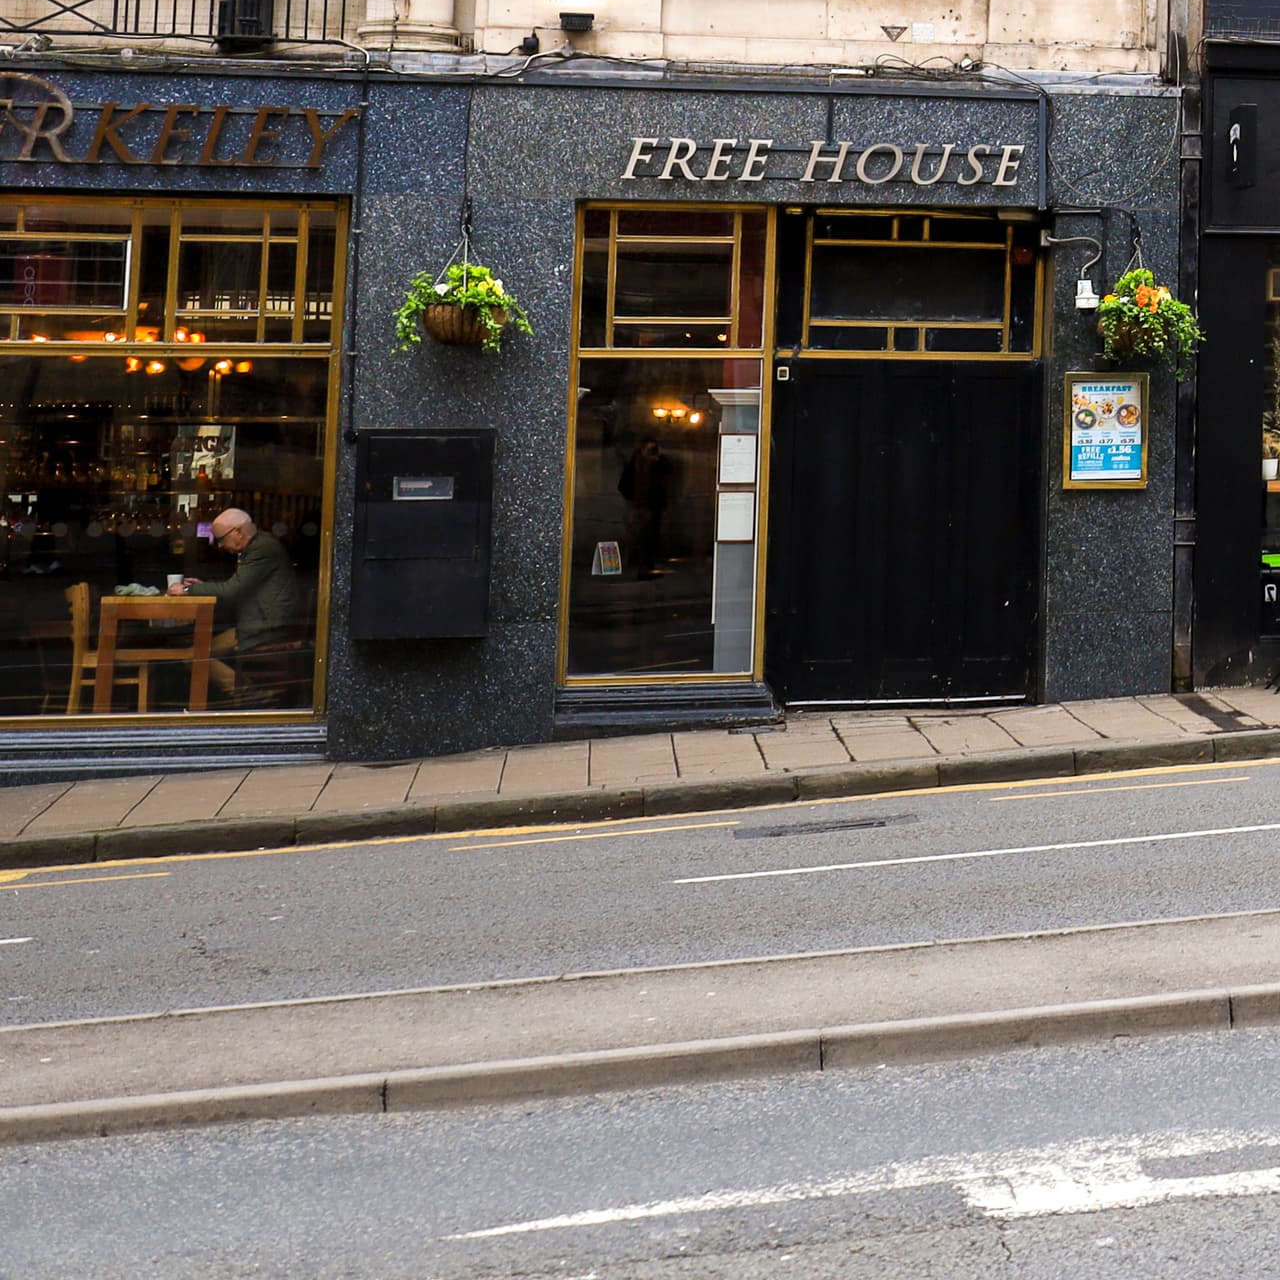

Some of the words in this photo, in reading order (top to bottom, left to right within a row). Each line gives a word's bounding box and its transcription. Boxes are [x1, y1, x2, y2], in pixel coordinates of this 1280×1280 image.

[0, 71, 362, 168] RKELEY
[621, 136, 773, 182] FREE
[799, 140, 1025, 187] HOUSE
